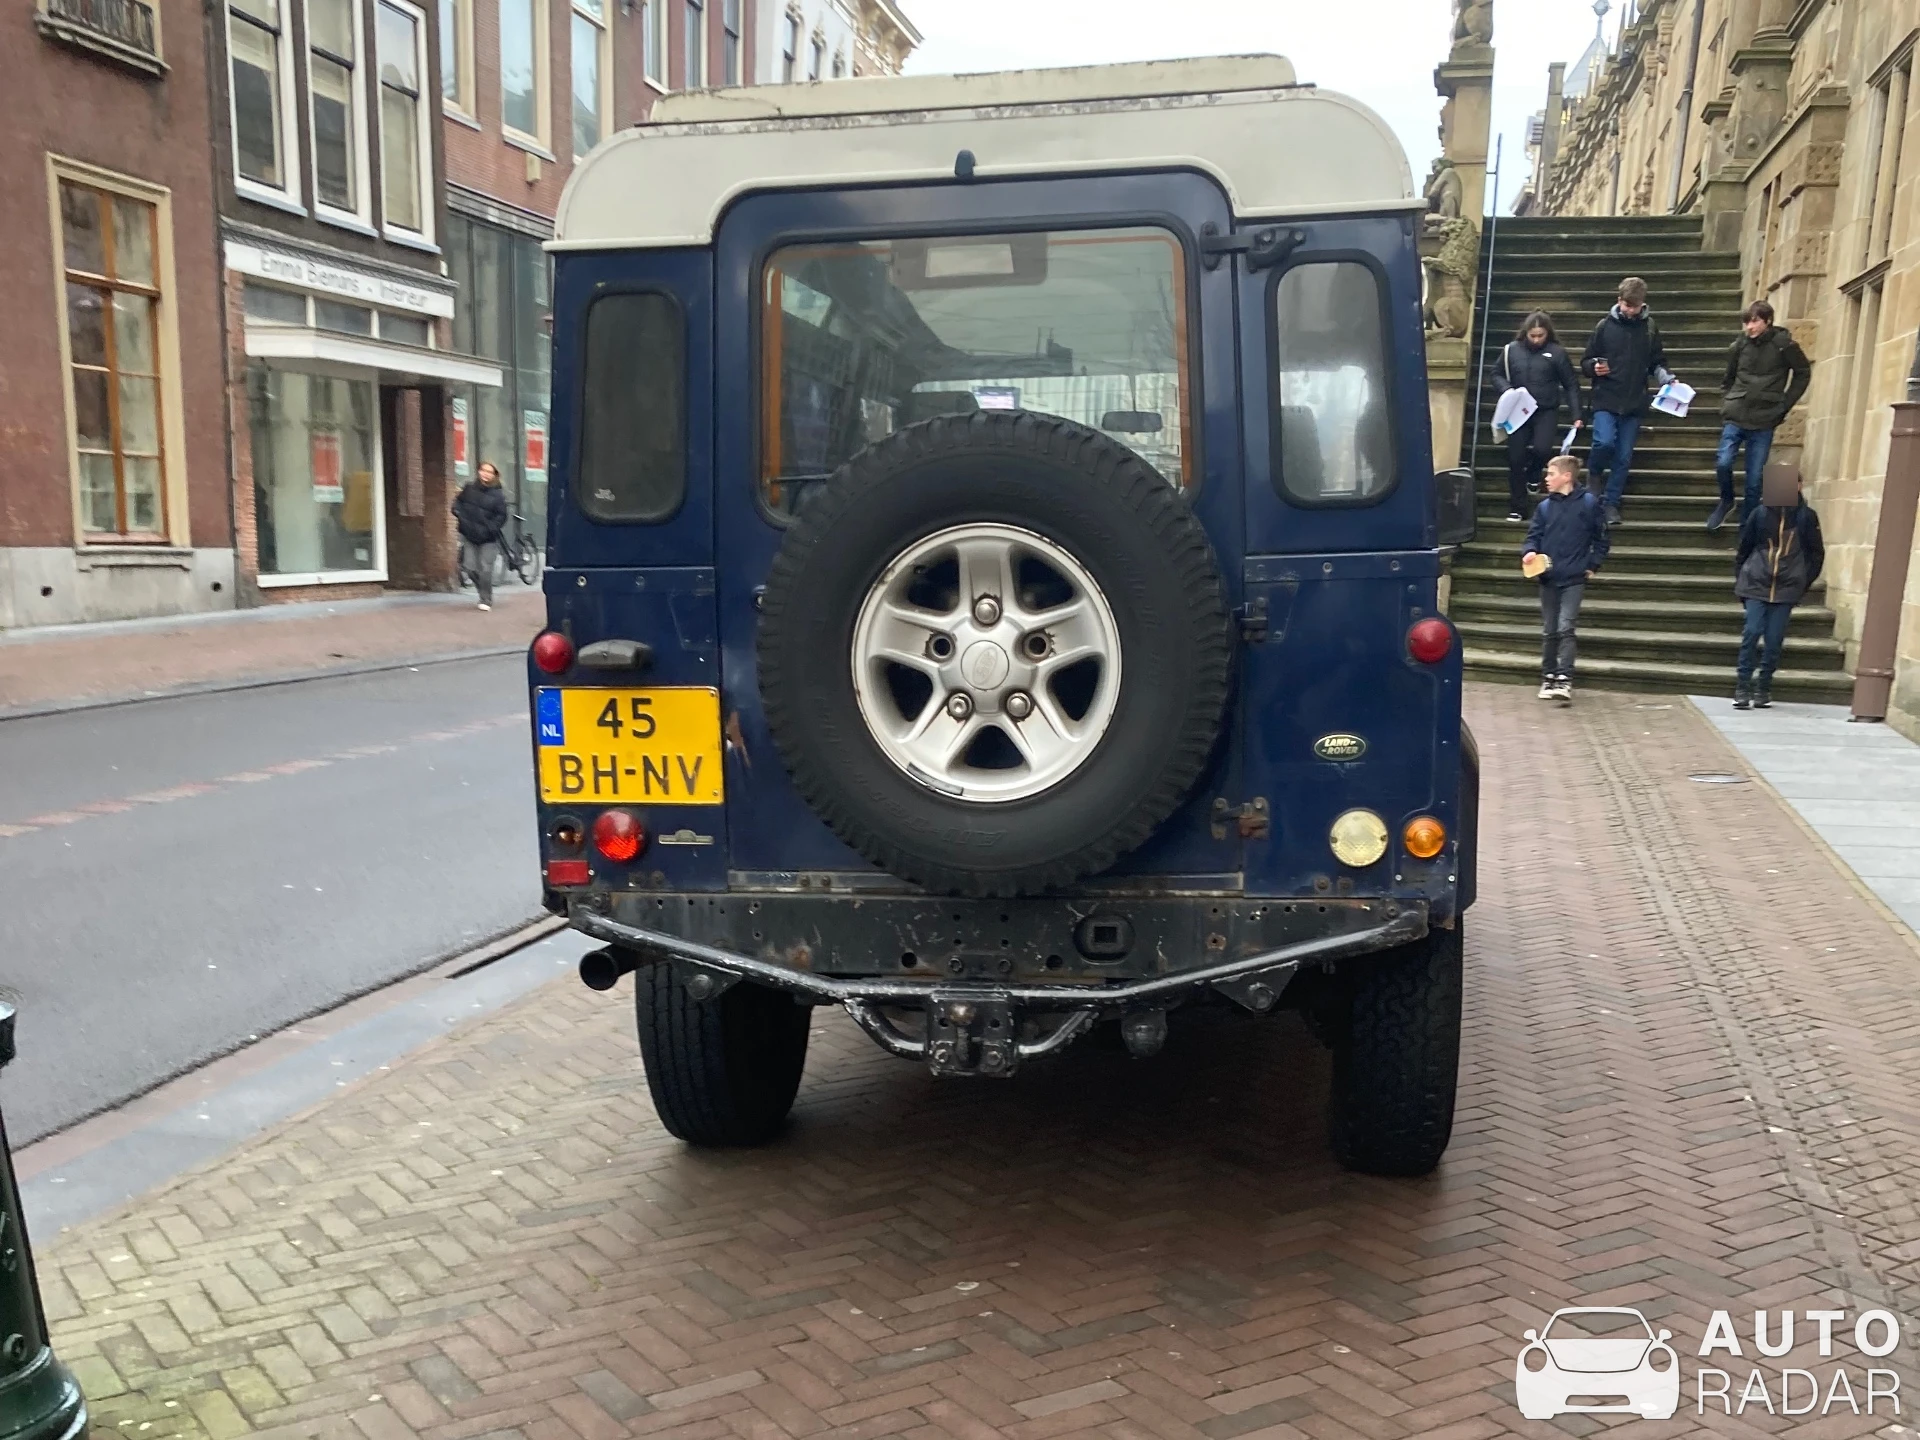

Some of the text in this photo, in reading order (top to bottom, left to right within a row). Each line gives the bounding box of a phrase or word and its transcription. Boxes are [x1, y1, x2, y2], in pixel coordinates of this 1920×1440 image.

[542, 724, 562, 738] NL
[596, 697, 657, 739] 45
[558, 753, 703, 796] BH-NV
